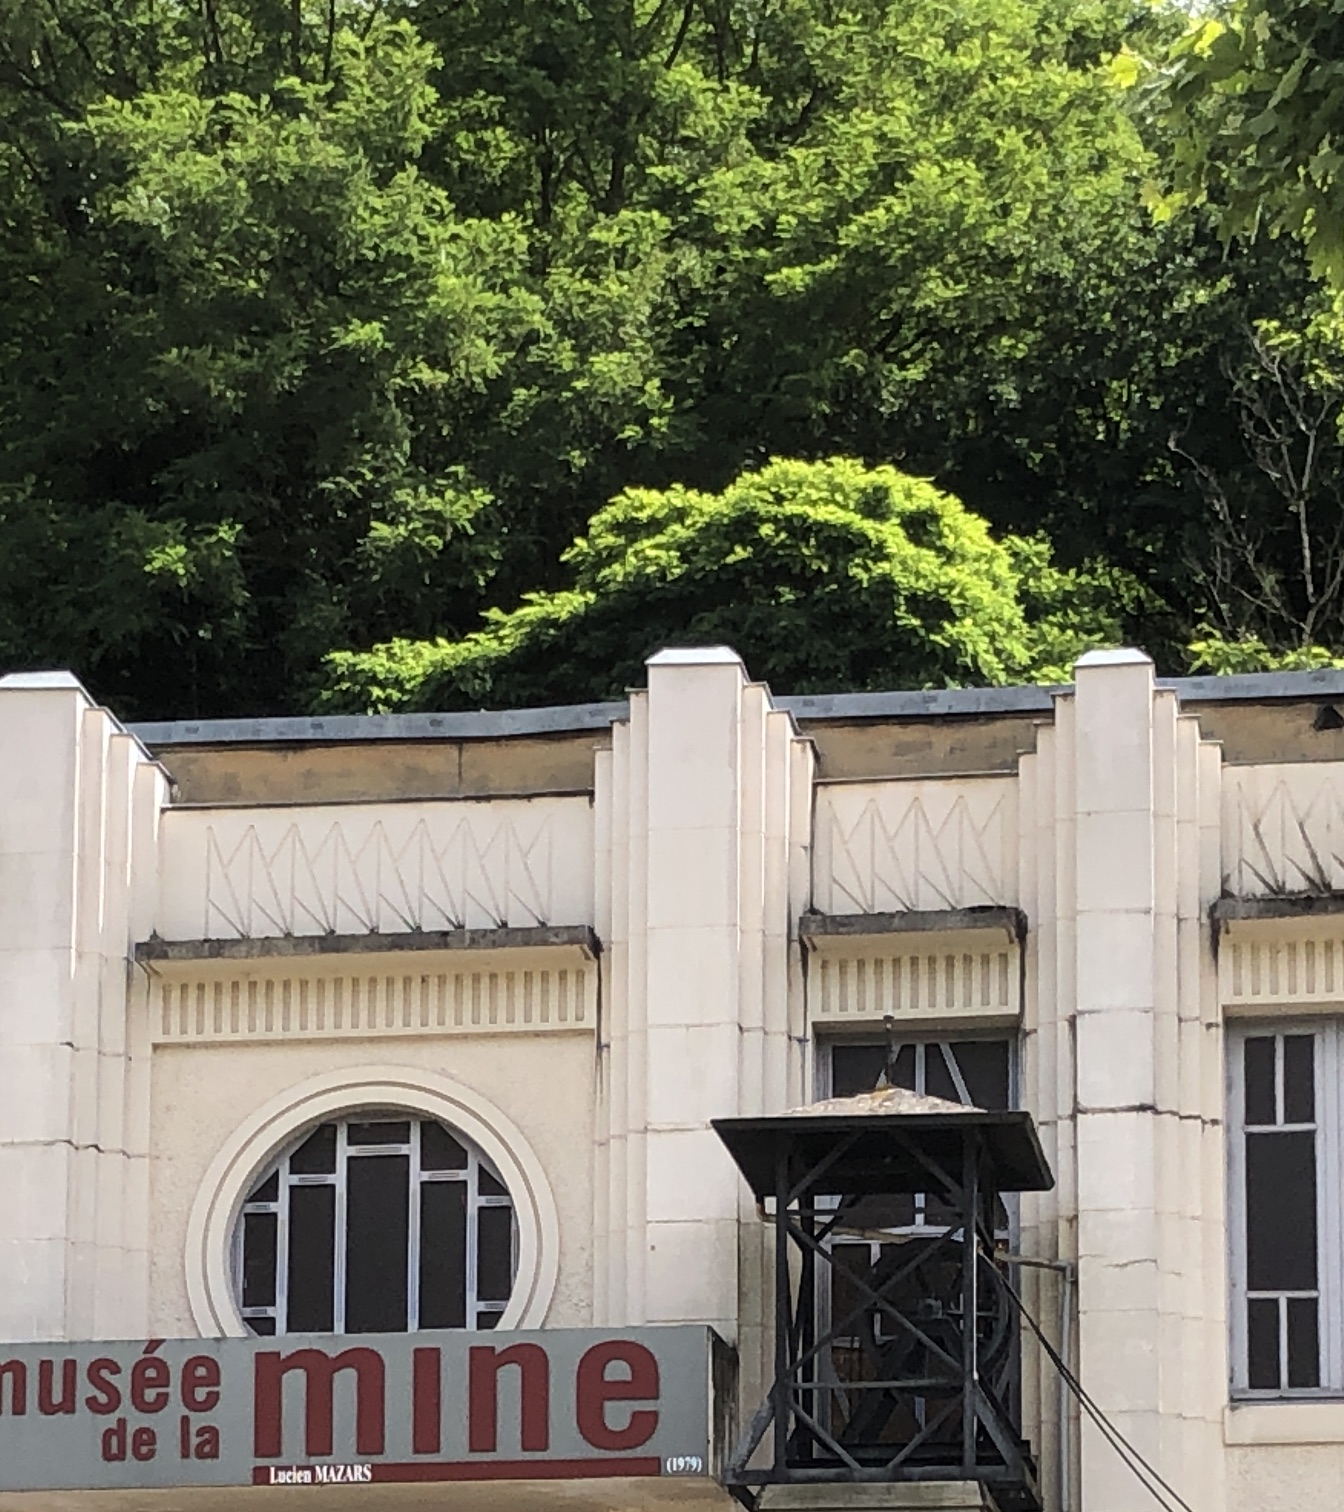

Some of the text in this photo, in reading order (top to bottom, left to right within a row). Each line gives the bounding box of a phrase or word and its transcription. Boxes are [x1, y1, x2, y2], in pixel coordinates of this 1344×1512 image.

[254, 1340, 660, 1458] mine
[102, 1415, 220, 1461] de la
[269, 1464, 372, 1484] Lucien MAZARS
[666, 1456, 702, 1473] (1979)
